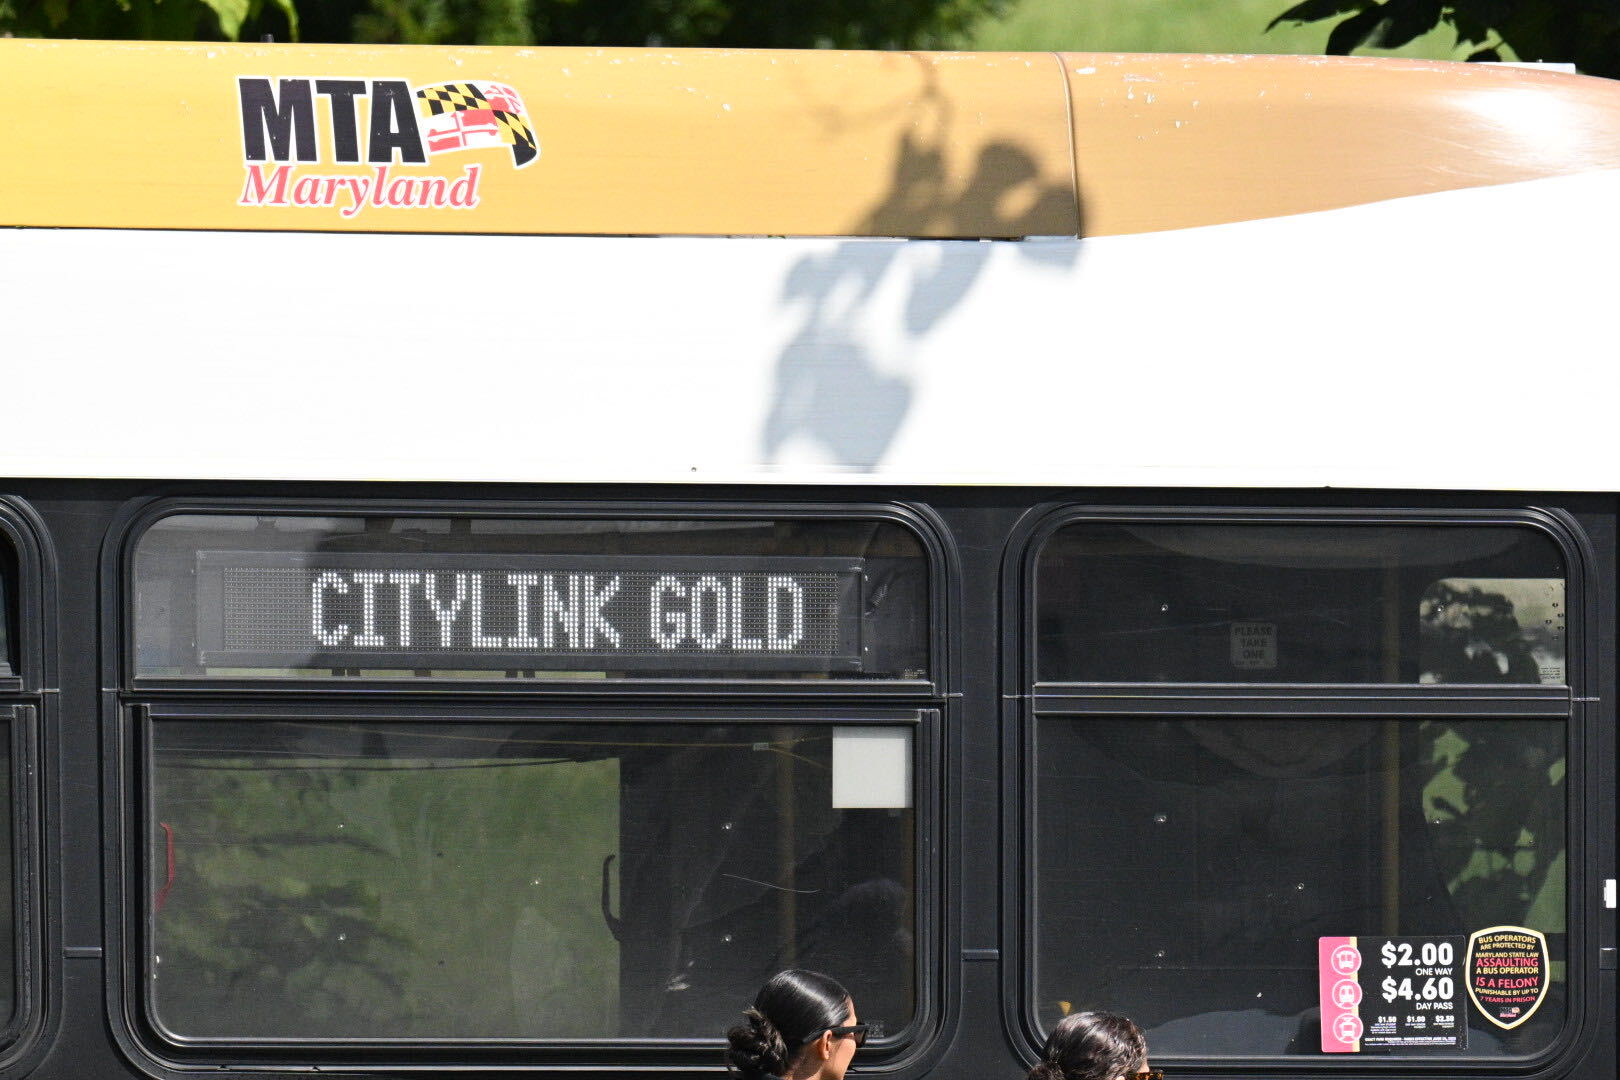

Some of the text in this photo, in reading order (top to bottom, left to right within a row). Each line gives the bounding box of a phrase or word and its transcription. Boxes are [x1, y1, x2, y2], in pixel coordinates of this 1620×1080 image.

[238, 78, 426, 163] MTA
[241, 165, 479, 216] Maryland
[312, 572, 802, 650] CITYLINK GOLD
[1478, 935, 1536, 944] BUS OPERATORS
[1382, 941, 1453, 968] $2.00
[1476, 958, 1538, 967] ASSAULTING
[1416, 968, 1433, 976] ONE
[1382, 976, 1454, 1003] $4.60
[1476, 977, 1538, 988] IS A FELONY
[1416, 1002, 1453, 1010] DAY PASS
